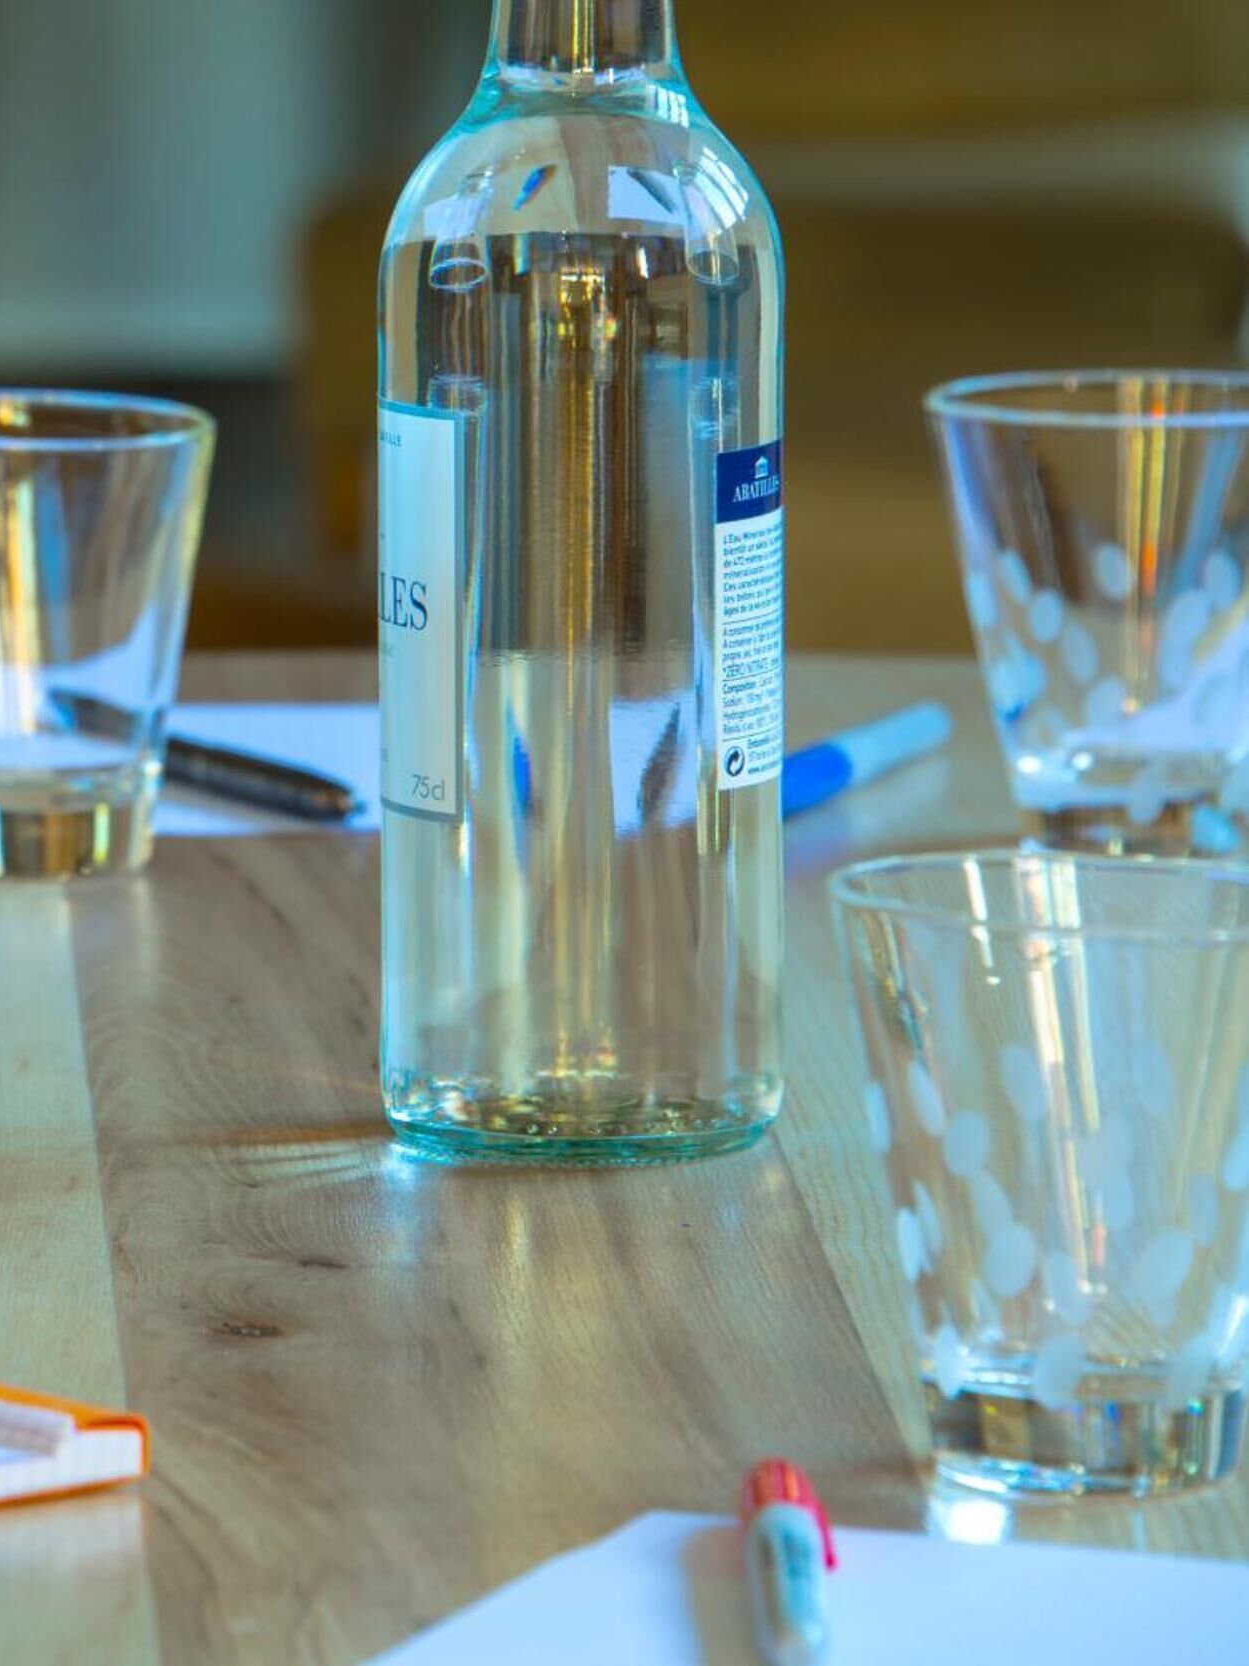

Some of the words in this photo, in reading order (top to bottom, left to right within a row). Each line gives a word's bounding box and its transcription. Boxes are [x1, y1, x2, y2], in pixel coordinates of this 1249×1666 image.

[732, 475, 779, 503] ABATILLE
[379, 572, 429, 631] LES
[411, 773, 445, 801] 75cl
